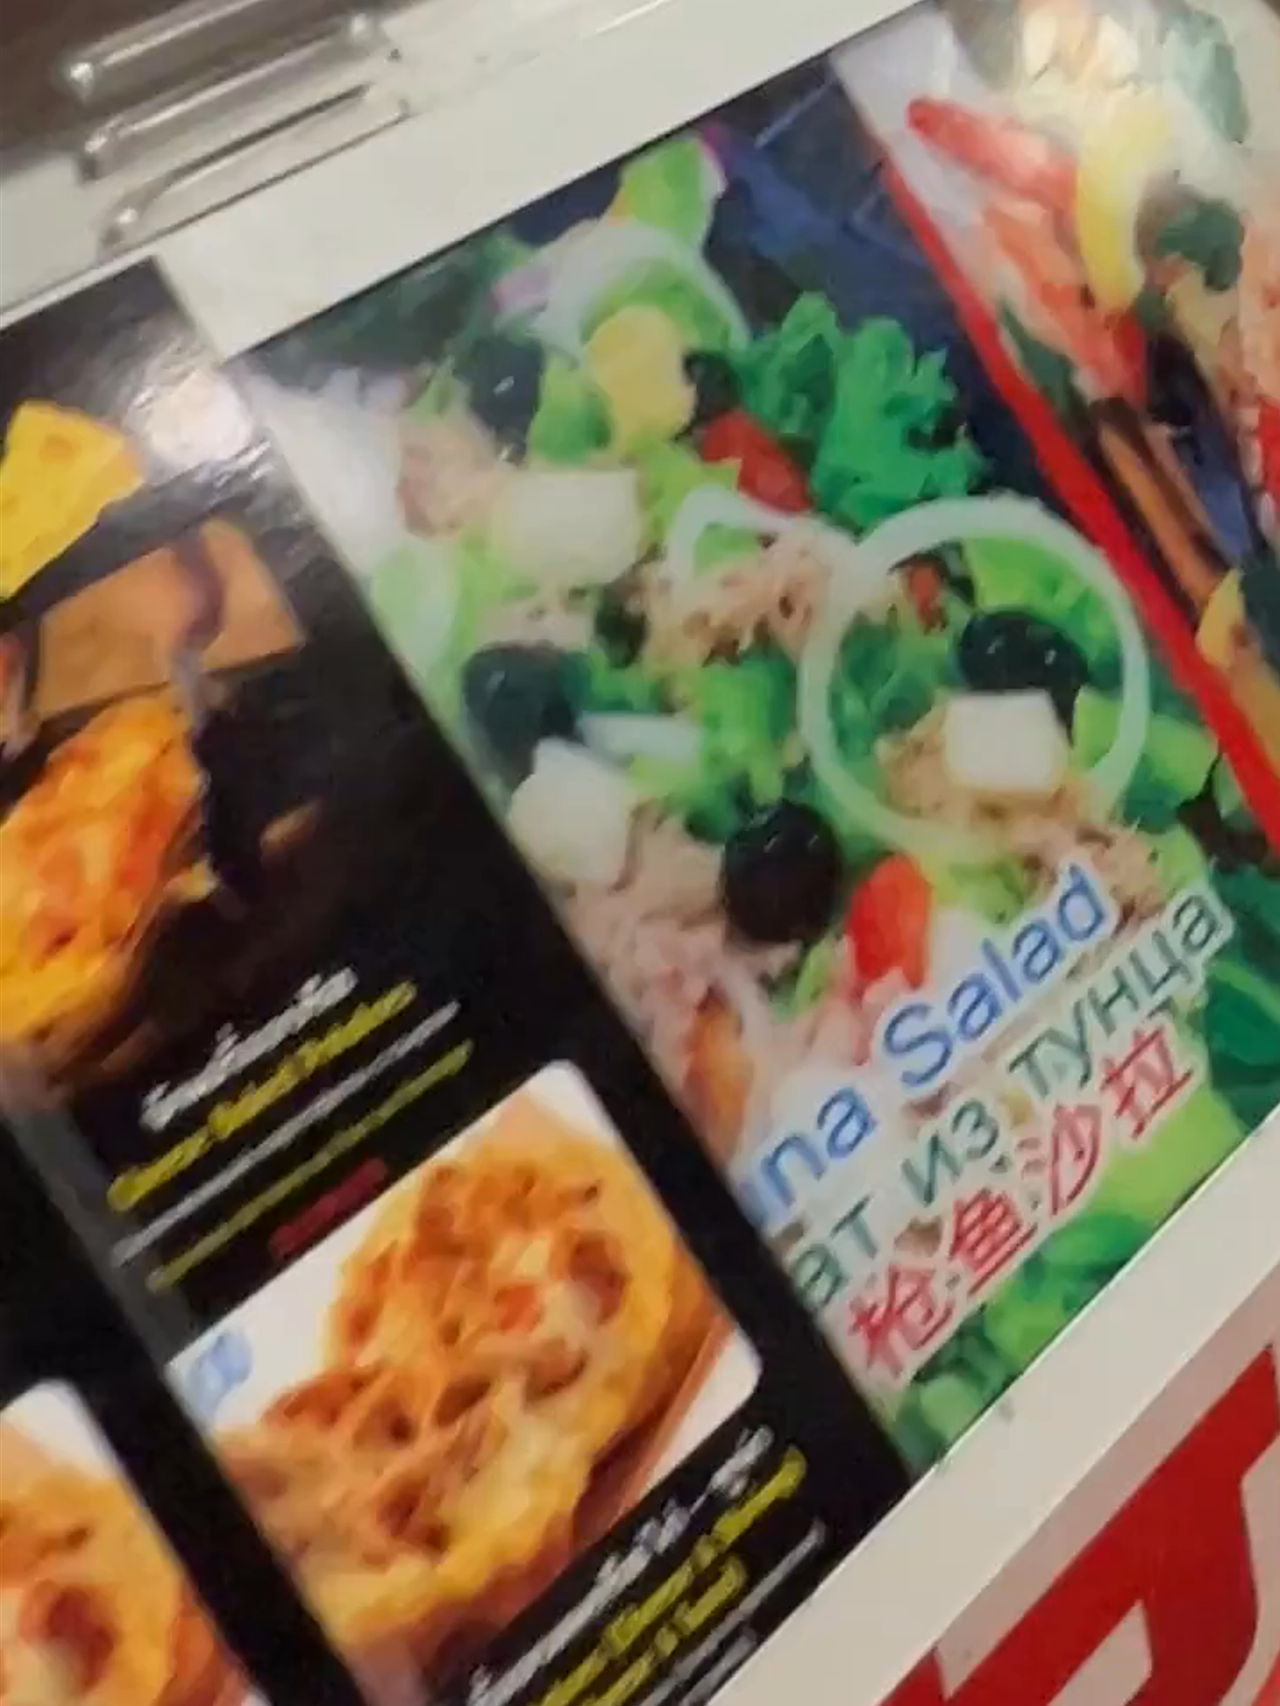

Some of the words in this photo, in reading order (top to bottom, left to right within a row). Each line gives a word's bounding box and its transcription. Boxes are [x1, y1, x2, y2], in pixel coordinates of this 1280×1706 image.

[881, 861, 1110, 1088] Salad
[899, 1097, 1001, 1209] из
[1008, 889, 1226, 1102] тунца
